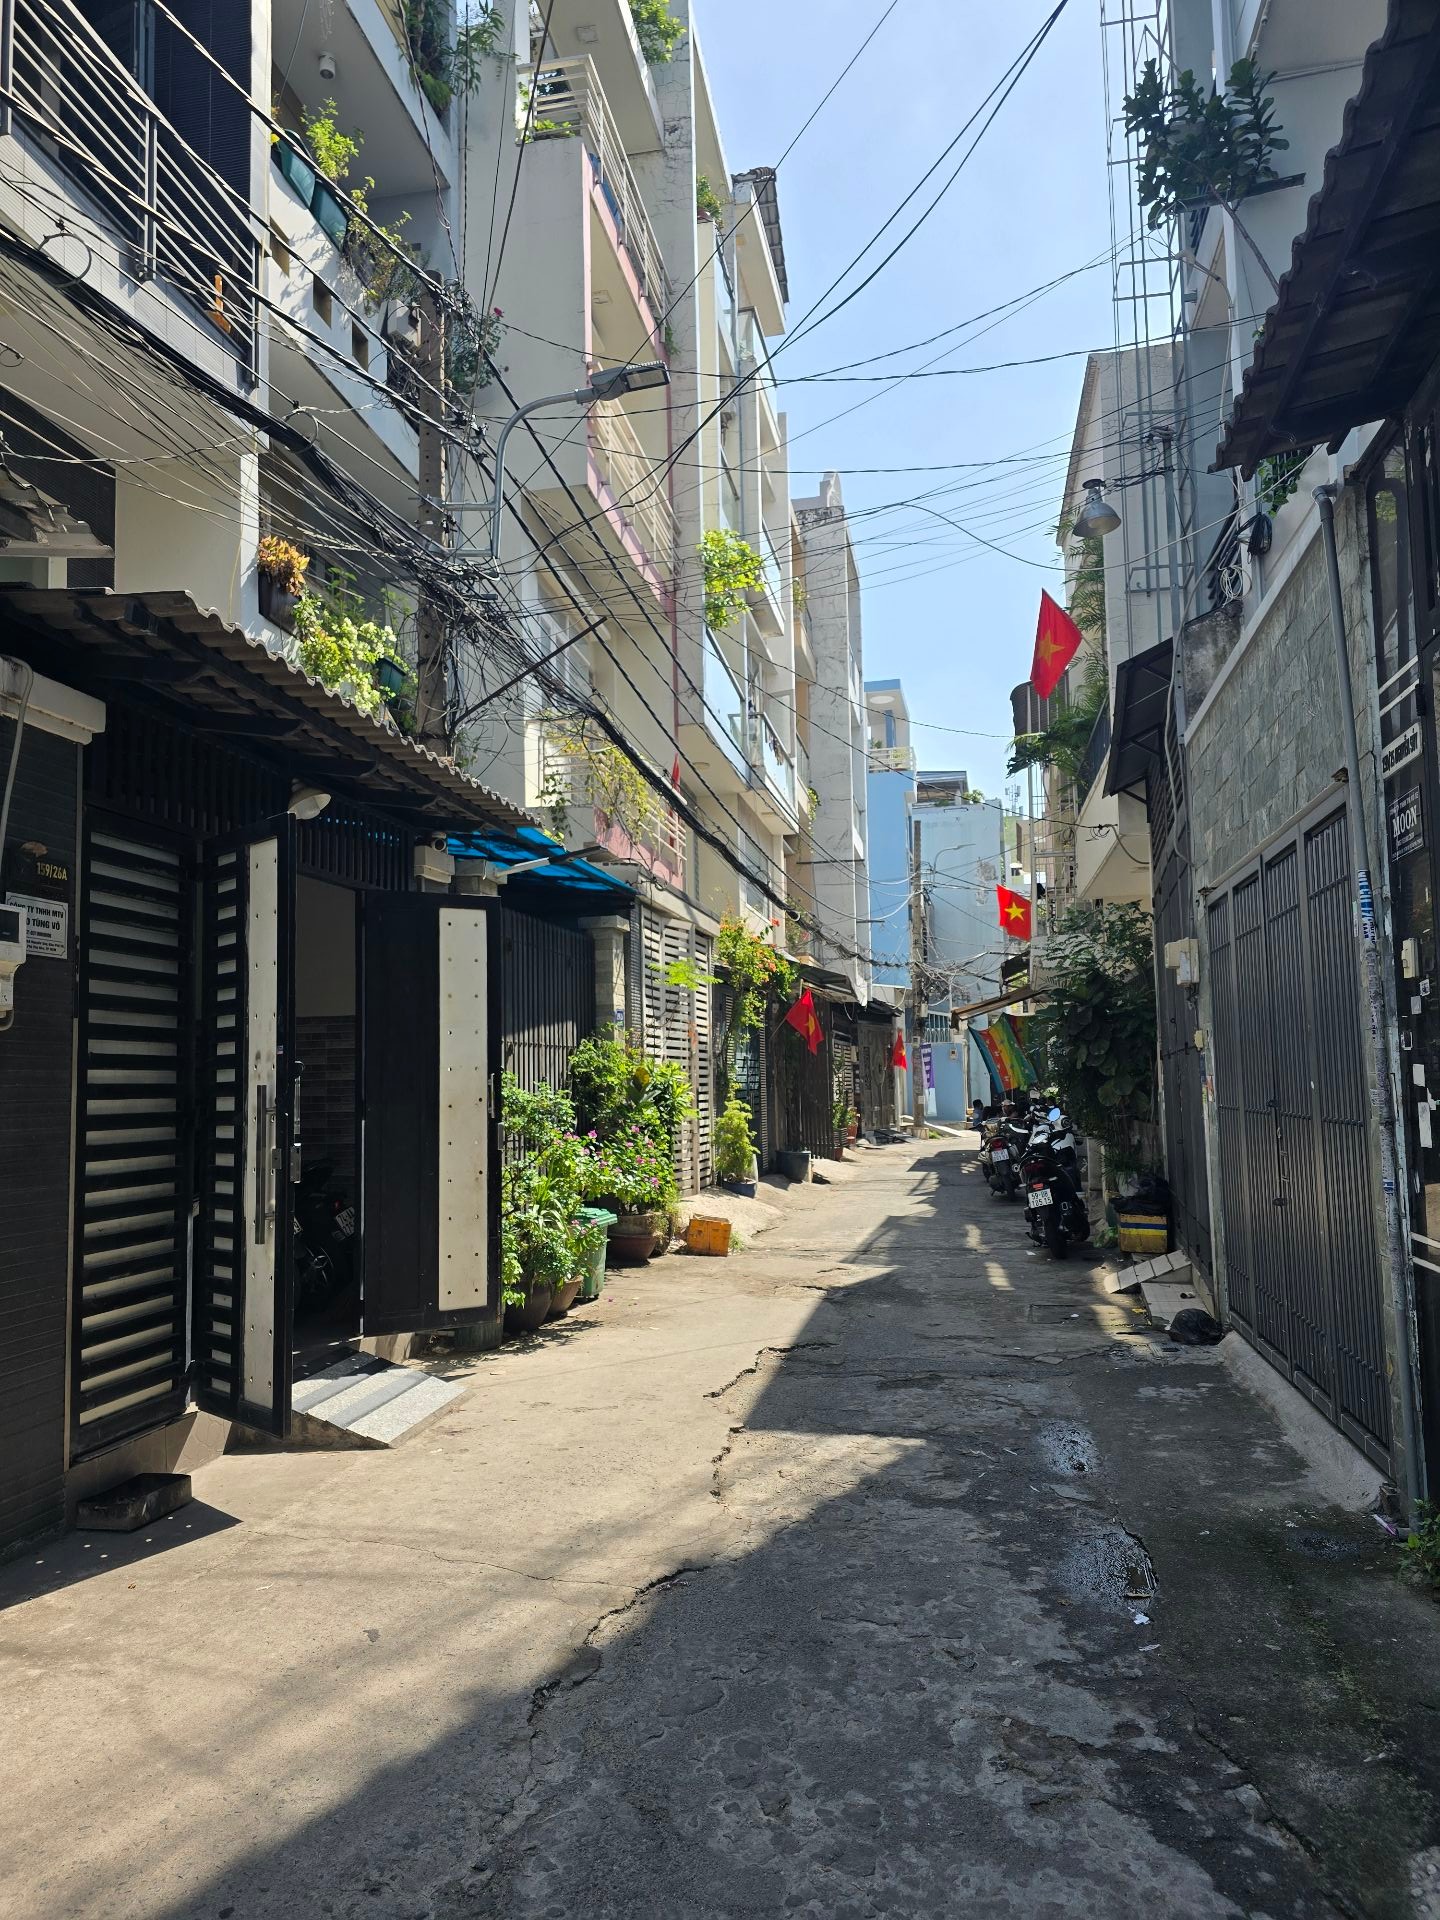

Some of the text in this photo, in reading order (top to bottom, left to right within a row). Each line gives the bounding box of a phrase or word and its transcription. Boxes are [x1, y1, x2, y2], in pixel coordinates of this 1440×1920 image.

[1392, 805, 1417, 838] MOON
[36, 862, 67, 880] 159/26A
[27, 905, 35, 913] TY
[36, 907, 51, 917] TNHH
[52, 910, 64, 919] MTV
